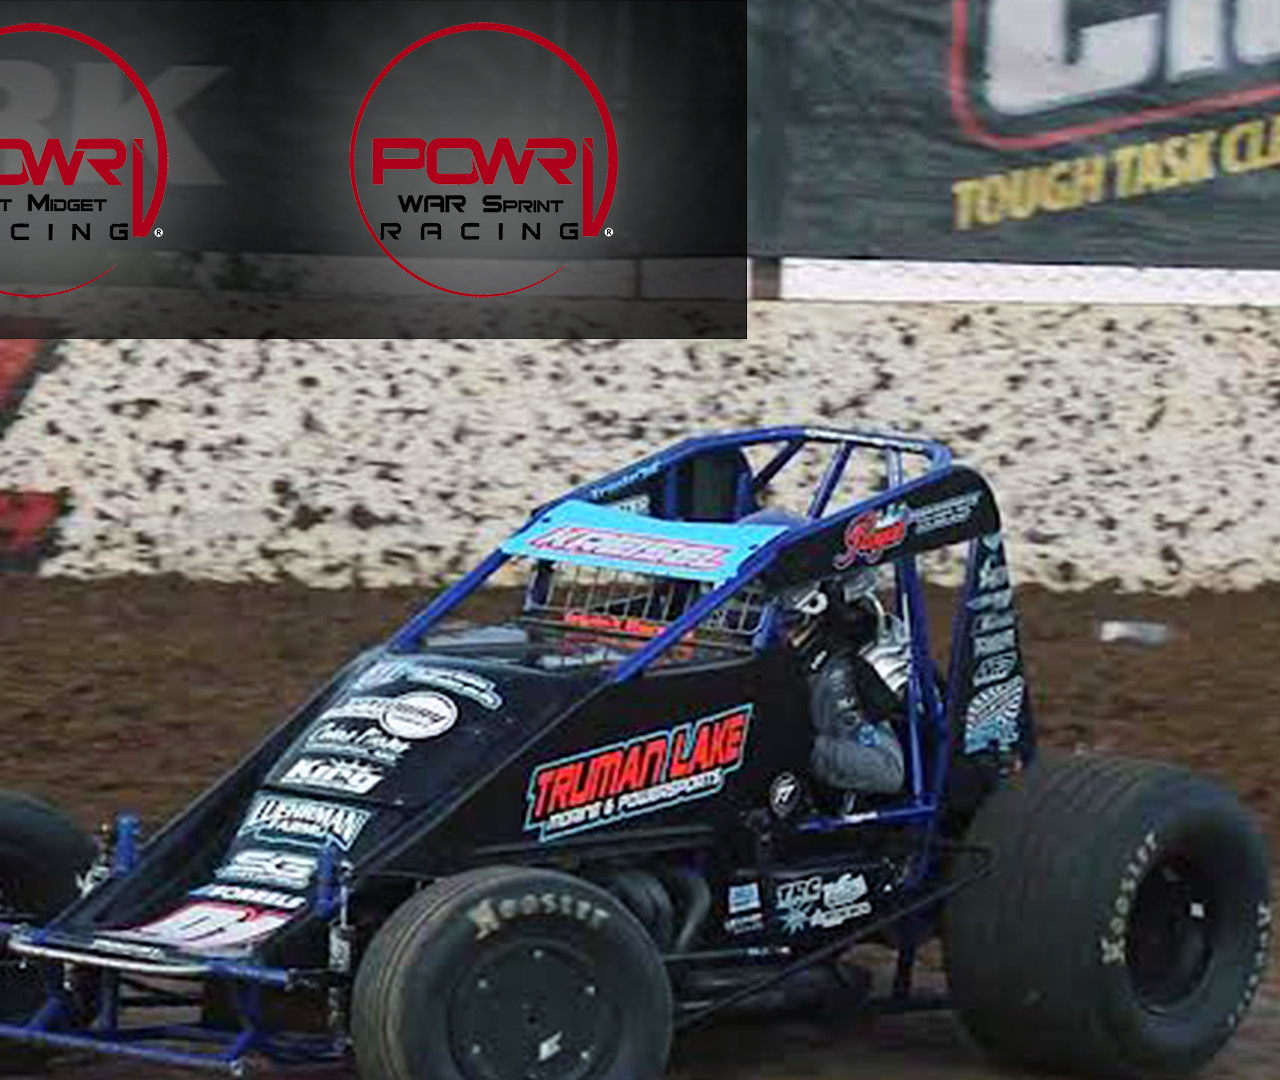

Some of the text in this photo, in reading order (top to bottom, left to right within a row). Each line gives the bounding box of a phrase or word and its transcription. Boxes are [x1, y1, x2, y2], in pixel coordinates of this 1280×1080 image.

[951, 154, 1108, 231] TOUGH
[1115, 130, 1217, 197] TASK
[669, 713, 746, 779] LAKE
